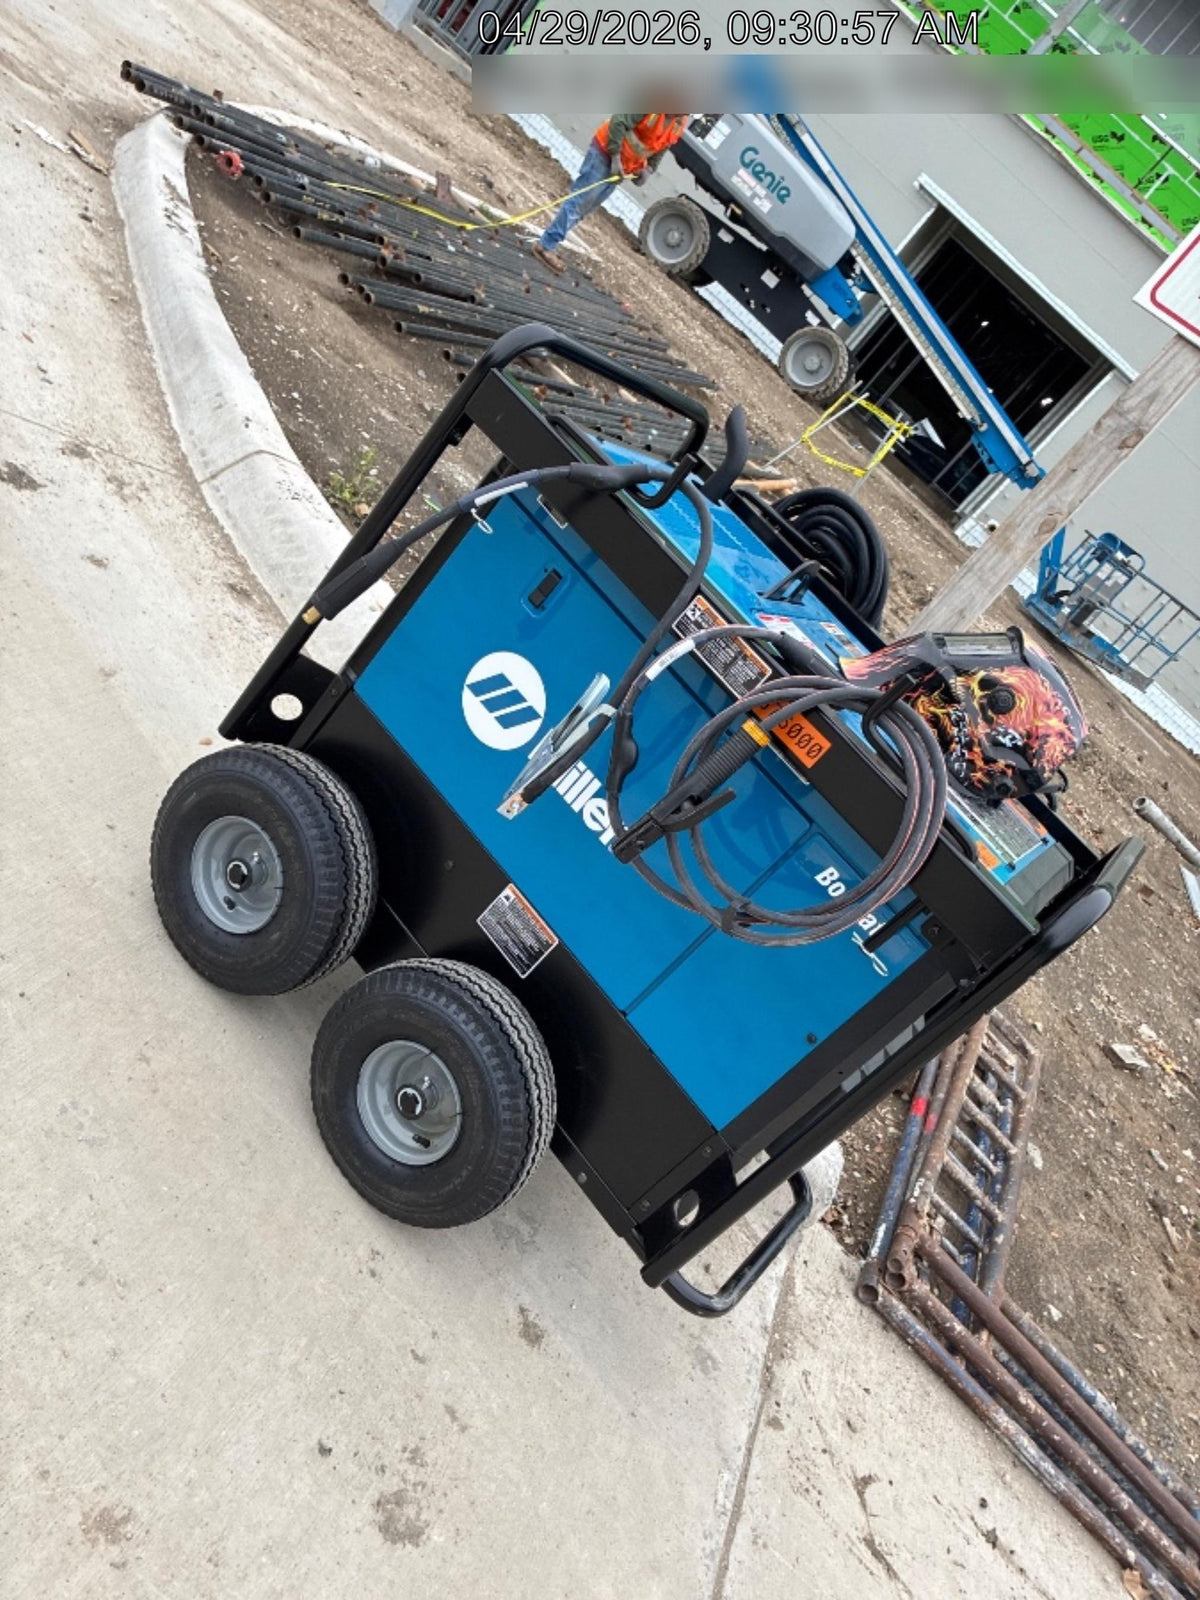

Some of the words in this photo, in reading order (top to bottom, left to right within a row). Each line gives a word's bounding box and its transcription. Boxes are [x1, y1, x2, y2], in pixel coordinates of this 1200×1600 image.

[739, 146, 791, 204] Genie
[552, 760, 628, 853] ille
[814, 866, 887, 936] Boat
